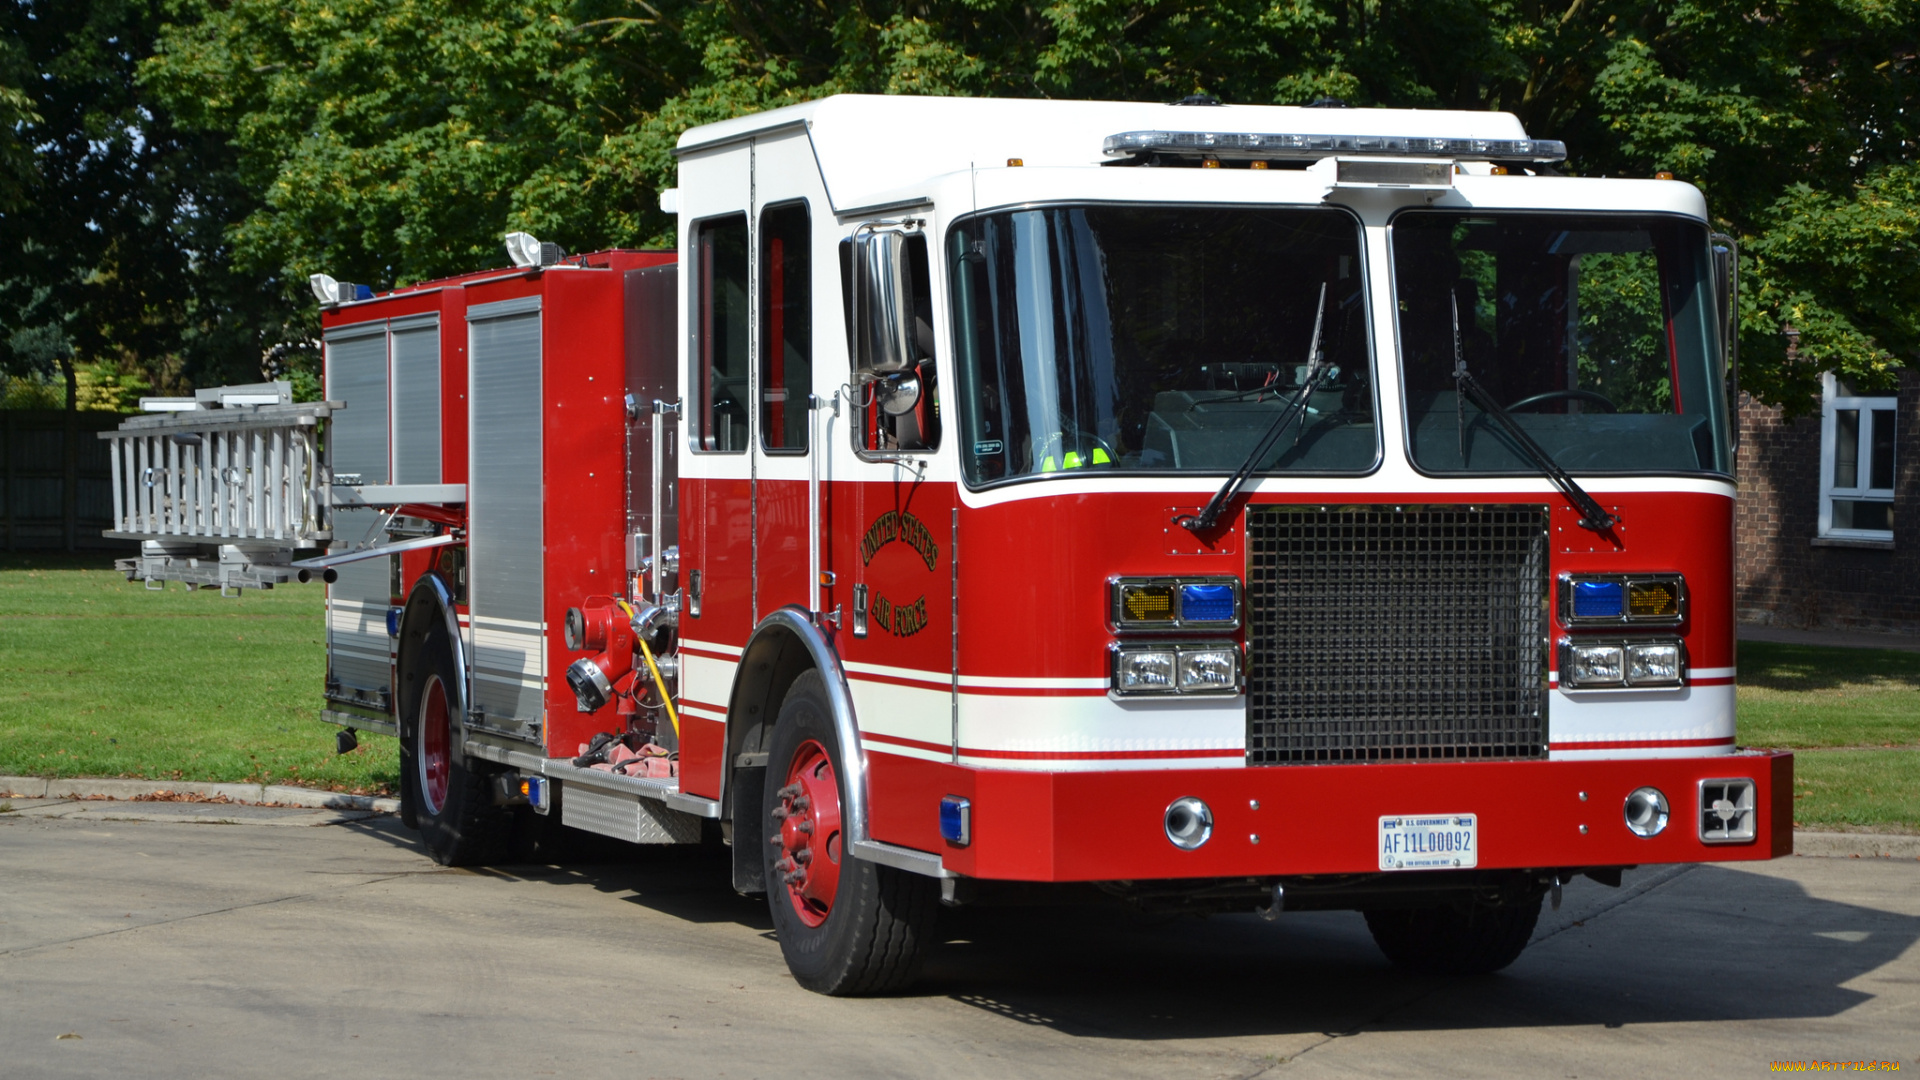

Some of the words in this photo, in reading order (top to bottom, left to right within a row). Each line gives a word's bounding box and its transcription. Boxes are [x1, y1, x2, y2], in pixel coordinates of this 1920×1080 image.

[860, 510, 899, 567] UNITED
[900, 511, 940, 572] STATES
[871, 591, 892, 632] AIR
[893, 595, 928, 638] FORCE
[1384, 831, 1471, 853] AF11L00092
